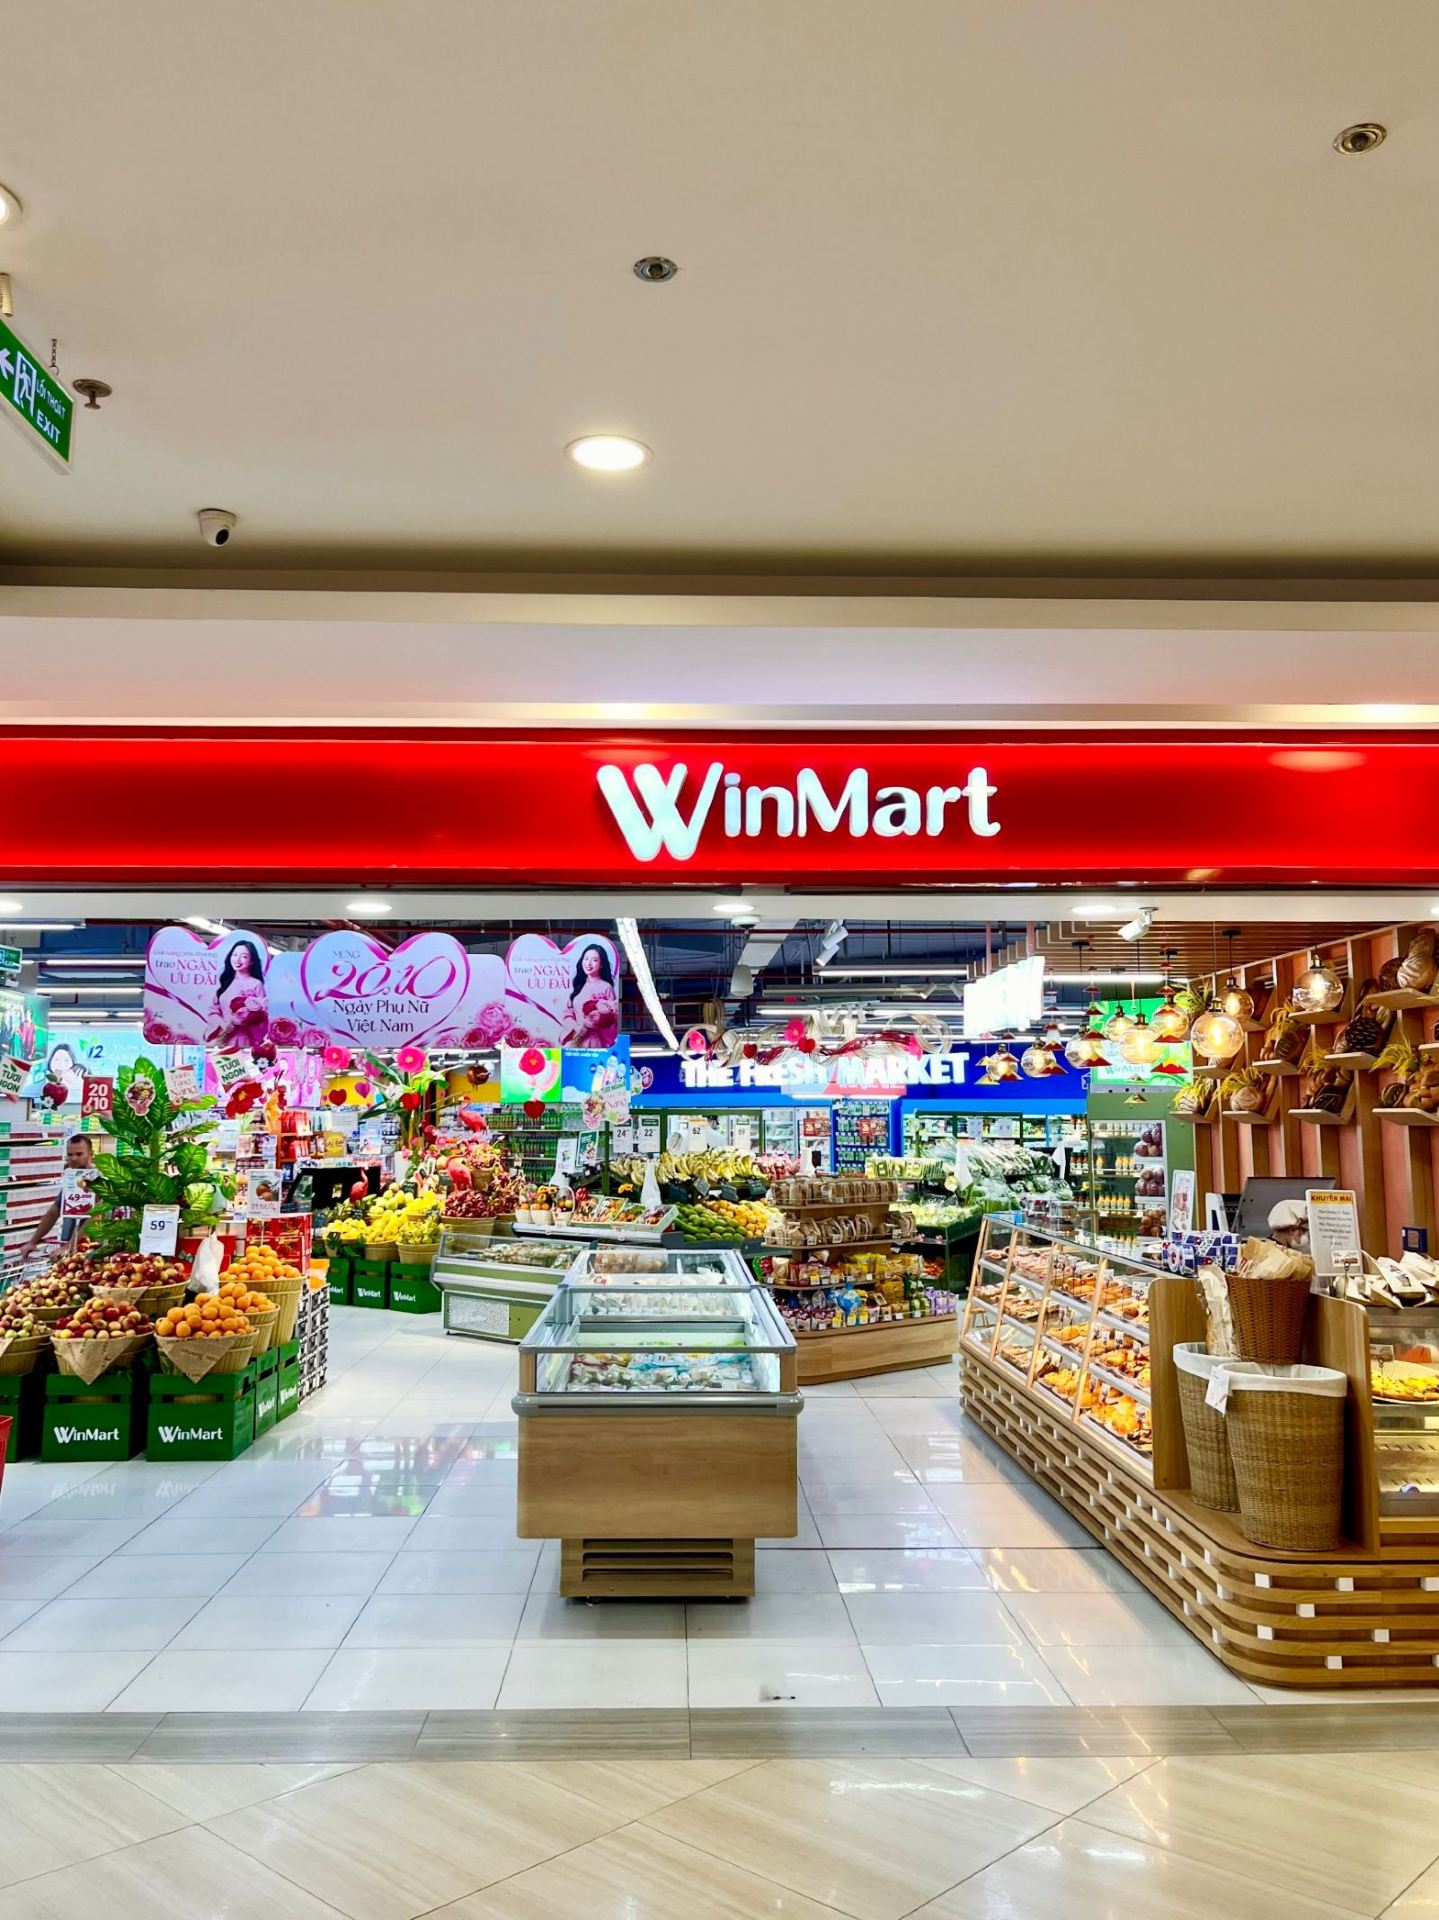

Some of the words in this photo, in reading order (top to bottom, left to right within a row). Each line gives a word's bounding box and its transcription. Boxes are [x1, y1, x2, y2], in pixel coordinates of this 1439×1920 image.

[36, 409, 61, 443] EXIT
[596, 762, 1001, 862] WinMart
[155, 960, 175, 968] trao
[171, 971, 190, 984] ƯU
[194, 972, 217, 985] ĐÃI
[333, 1000, 373, 1015] Ngày
[376, 1000, 404, 1014] Phụ
[407, 1000, 429, 1013] Nữ
[347, 1019, 375, 1034] Việt
[379, 1020, 414, 1032] Nam
[88, 1044, 104, 1058] 12
[220, 1058, 240, 1072] TƯƠI
[680, 1060, 734, 1087] THE
[740, 1055, 828, 1086] FRESH
[838, 1052, 970, 1085] MARKET
[221, 1067, 246, 1081] NGON
[88, 1083, 108, 1096] 20
[150, 1220, 166, 1231] 59
[53, 1426, 120, 1444] WinMart
[158, 1425, 223, 1443] WinMart
